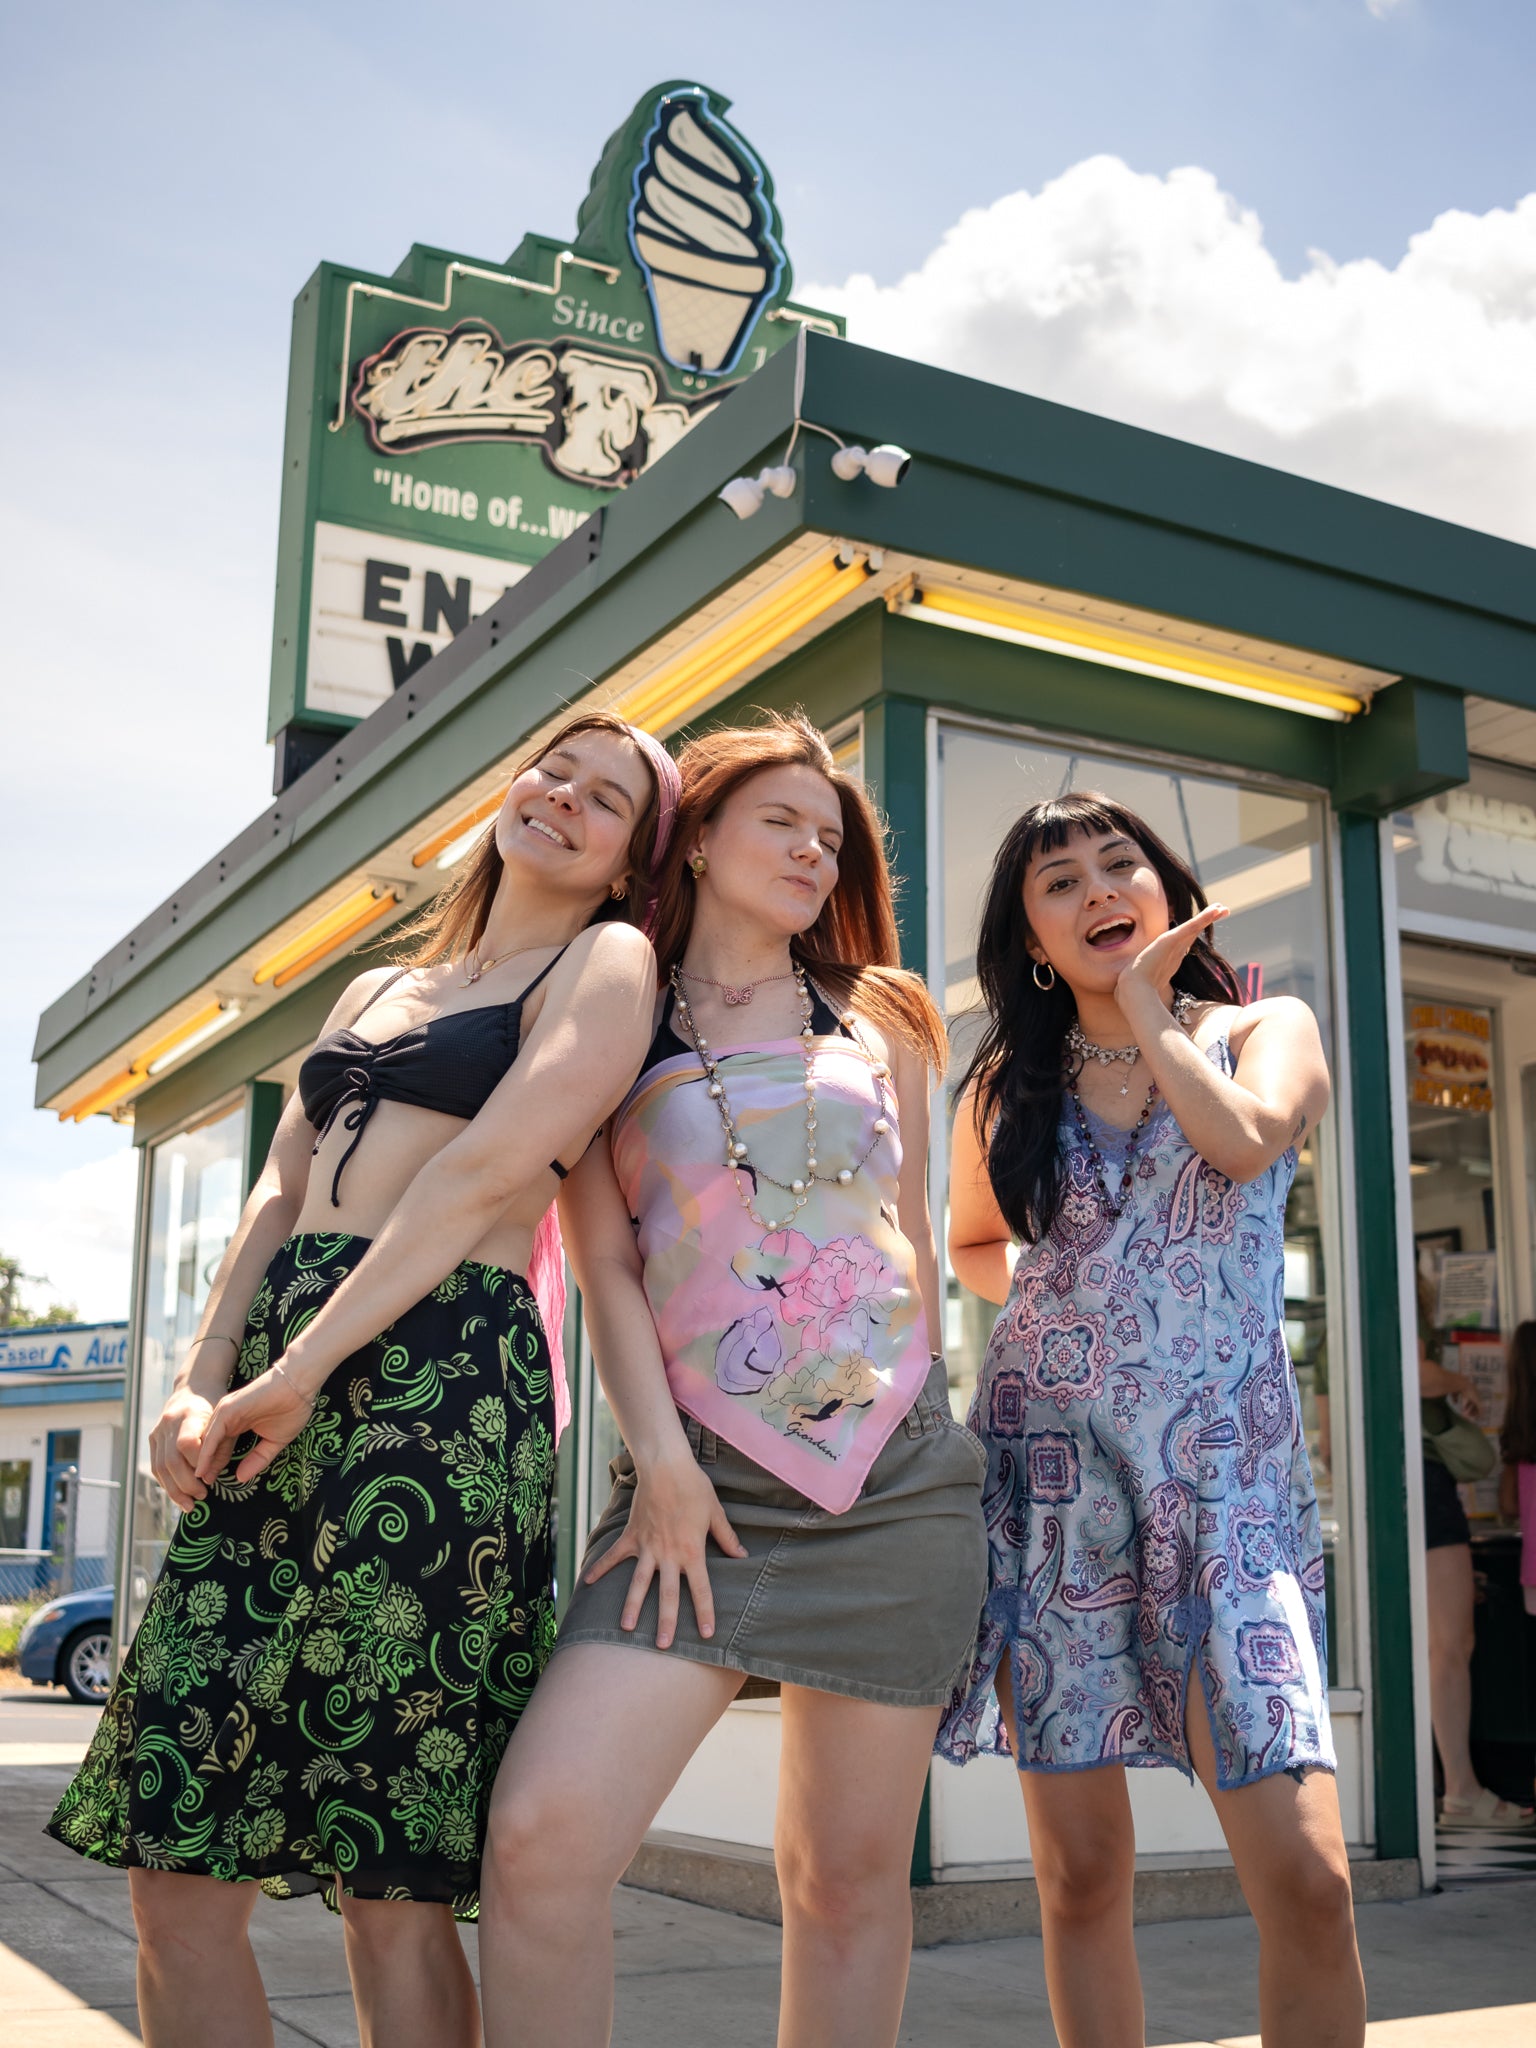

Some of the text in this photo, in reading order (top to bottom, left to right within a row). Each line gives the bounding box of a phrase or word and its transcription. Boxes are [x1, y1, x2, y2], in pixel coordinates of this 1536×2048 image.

[552, 296, 645, 343] Since
[359, 333, 557, 422] the
[373, 467, 479, 521] "Home
[363, 559, 510, 637] EN
